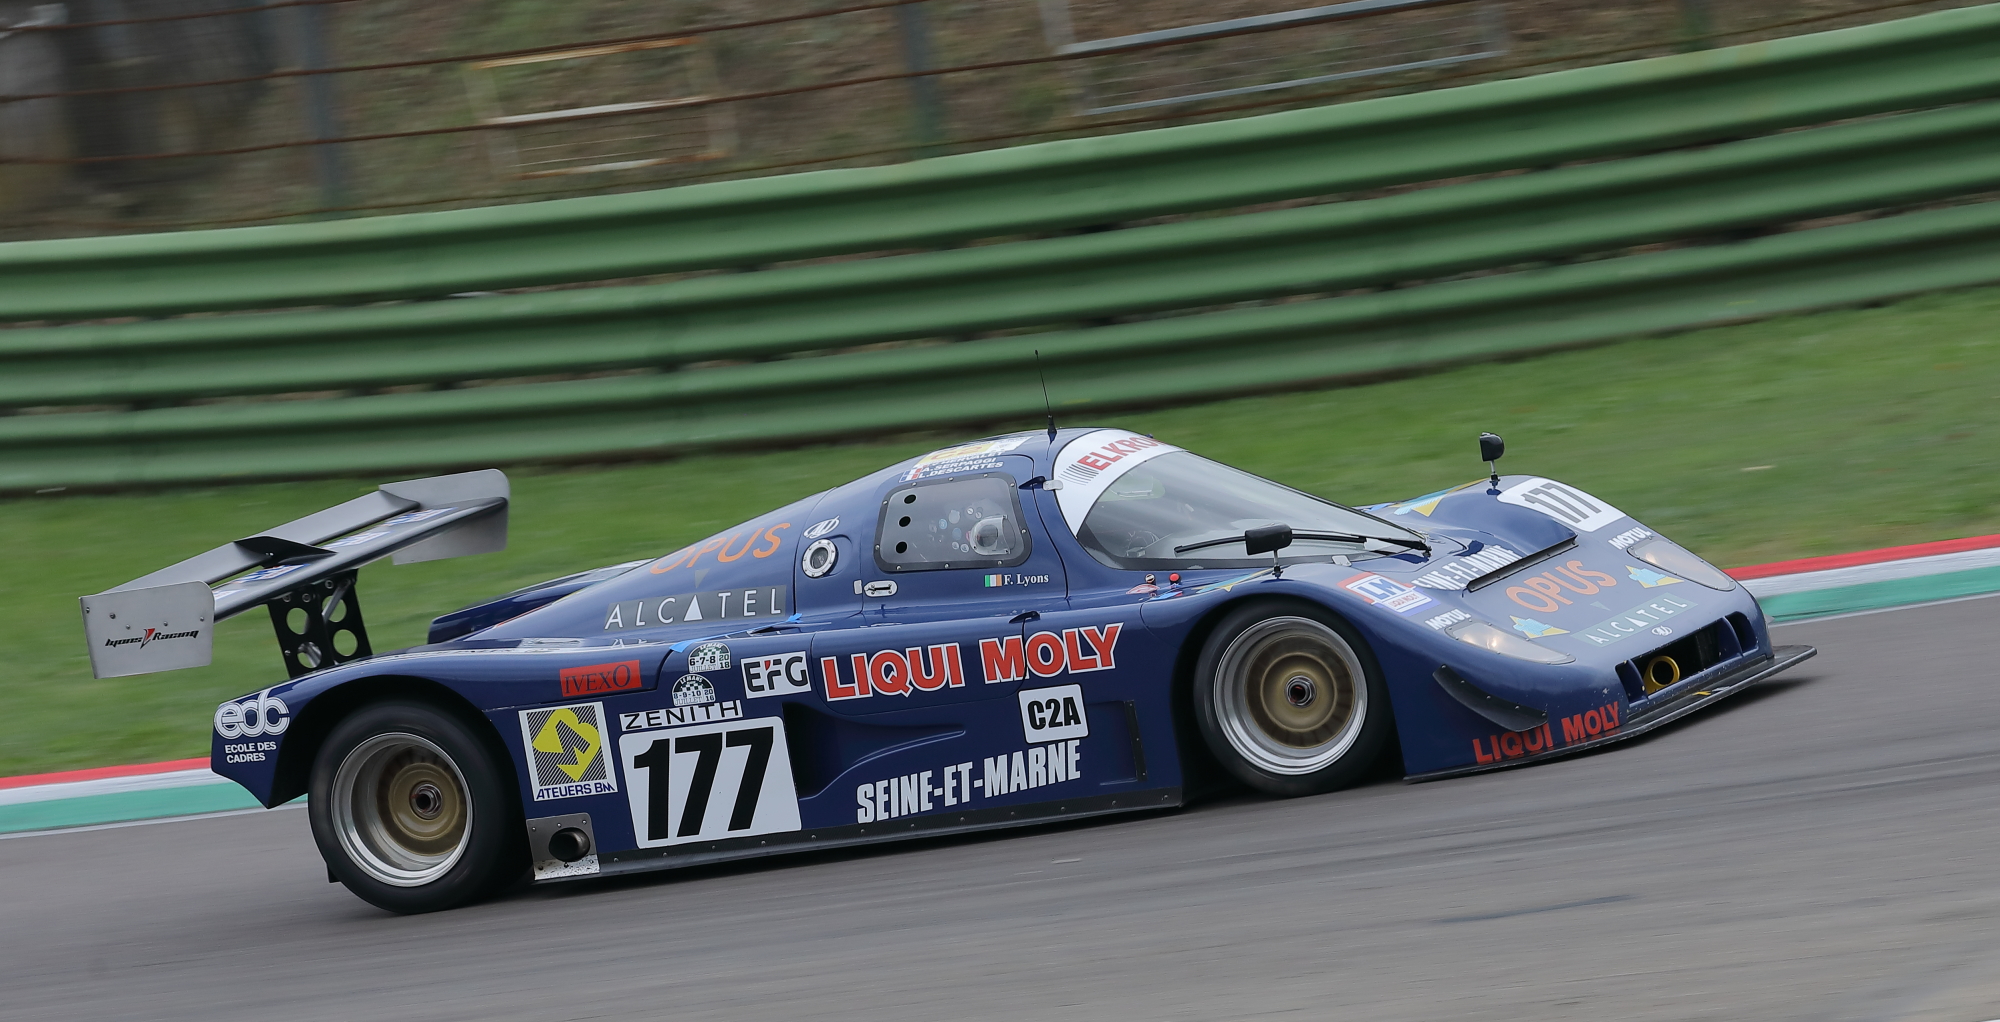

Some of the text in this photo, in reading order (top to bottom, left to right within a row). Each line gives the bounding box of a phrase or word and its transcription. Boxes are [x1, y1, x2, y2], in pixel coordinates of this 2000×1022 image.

[918, 461, 1004, 479] L.DESCARTES
[1077, 437, 1166, 471] ELKRO
[1521, 482, 1602, 525] 177
[650, 523, 790, 574] OPUS
[1608, 526, 1652, 550] MOTUL
[1003, 573, 1049, 587] F. Lyons
[1357, 578, 1406, 601] LM
[1506, 560, 1617, 612] OPUS
[604, 588, 781, 630] ALCATEL
[1425, 608, 1472, 631] MOTUL
[1585, 598, 1688, 644] ALCATEL
[689, 655, 716, 666] 6-7-8
[743, 655, 809, 693] EFG
[820, 621, 1125, 702] LIQUI MOLY
[564, 664, 632, 694] IVEXO
[624, 703, 739, 729] ZENITH
[1027, 696, 1082, 730] C2A
[224, 741, 277, 754] ECOLE DES
[1472, 701, 1620, 764] LIQUI MOLY
[226, 752, 266, 764] CADRES
[633, 726, 774, 842] 177
[856, 739, 1081, 824] SEINE-ET-MARNE
